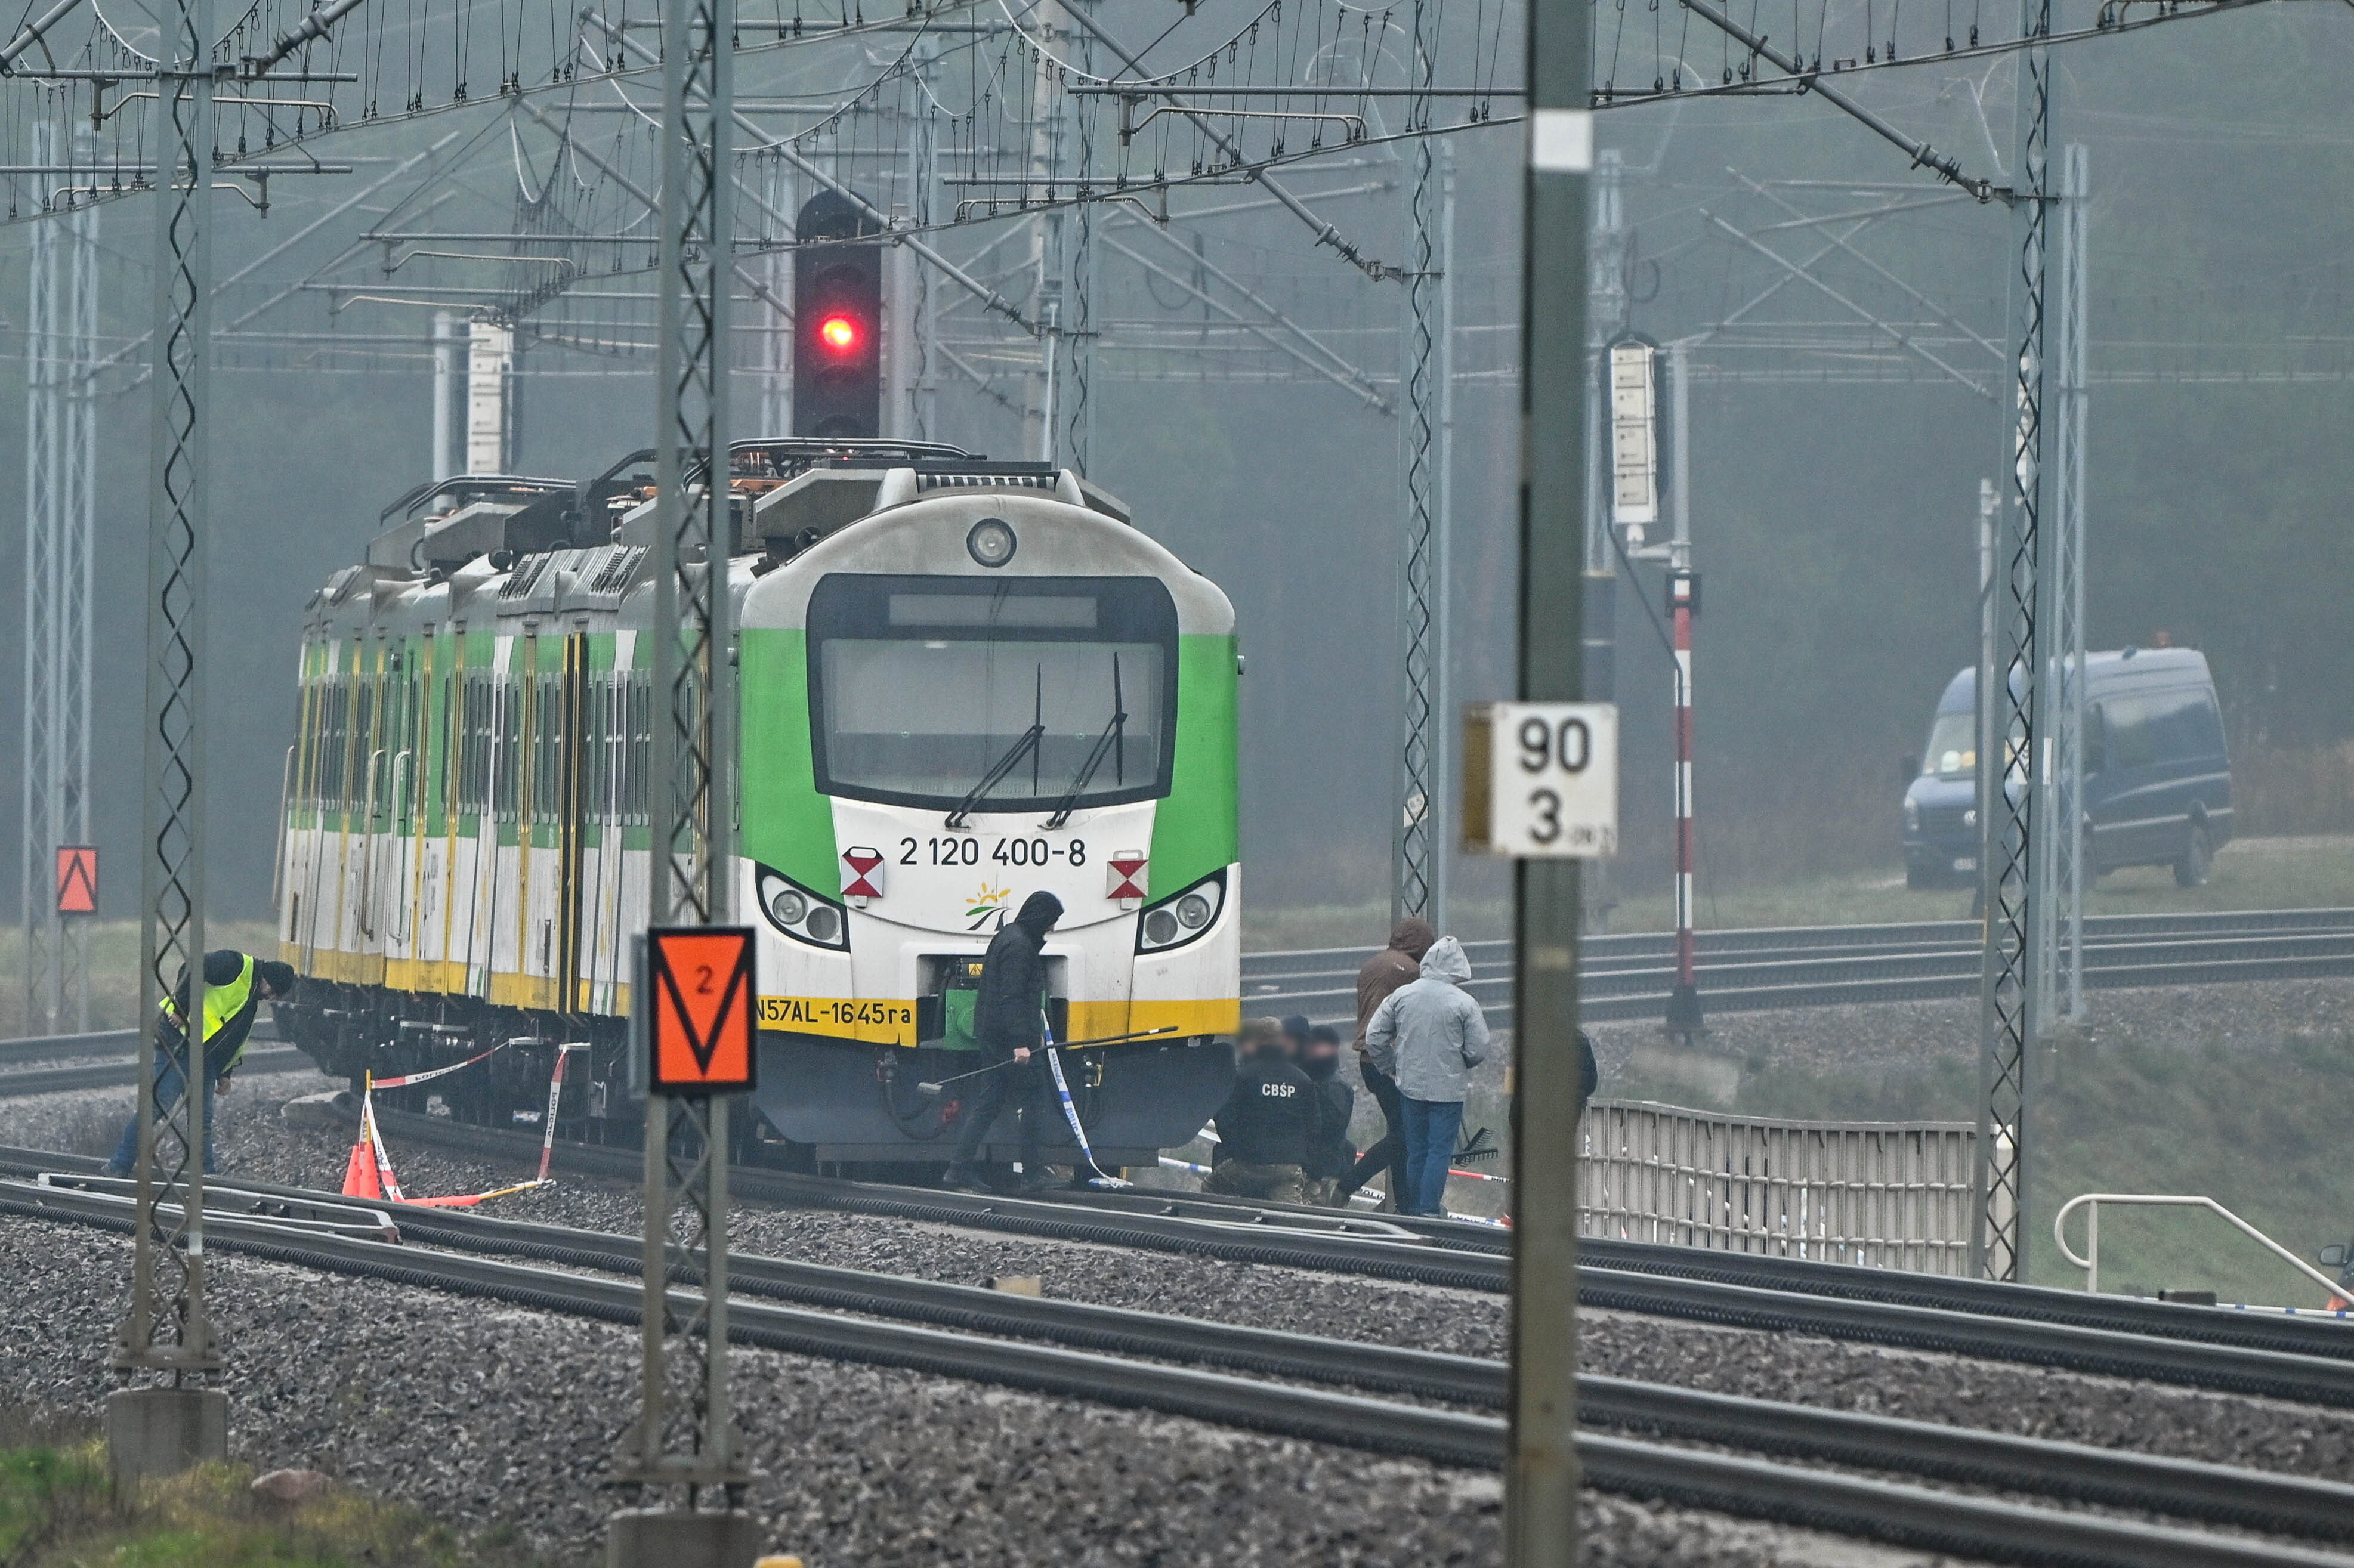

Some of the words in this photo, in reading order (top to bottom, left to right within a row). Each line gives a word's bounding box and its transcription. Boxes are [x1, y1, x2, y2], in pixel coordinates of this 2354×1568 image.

[1518, 717, 1590, 774] 90
[1528, 787, 1561, 844] 3
[900, 837, 917, 865] 2
[929, 837, 979, 865] 120
[992, 838, 1086, 867] 400-8
[696, 964, 713, 994] 2
[1262, 1082, 1295, 1097] CBŚP
